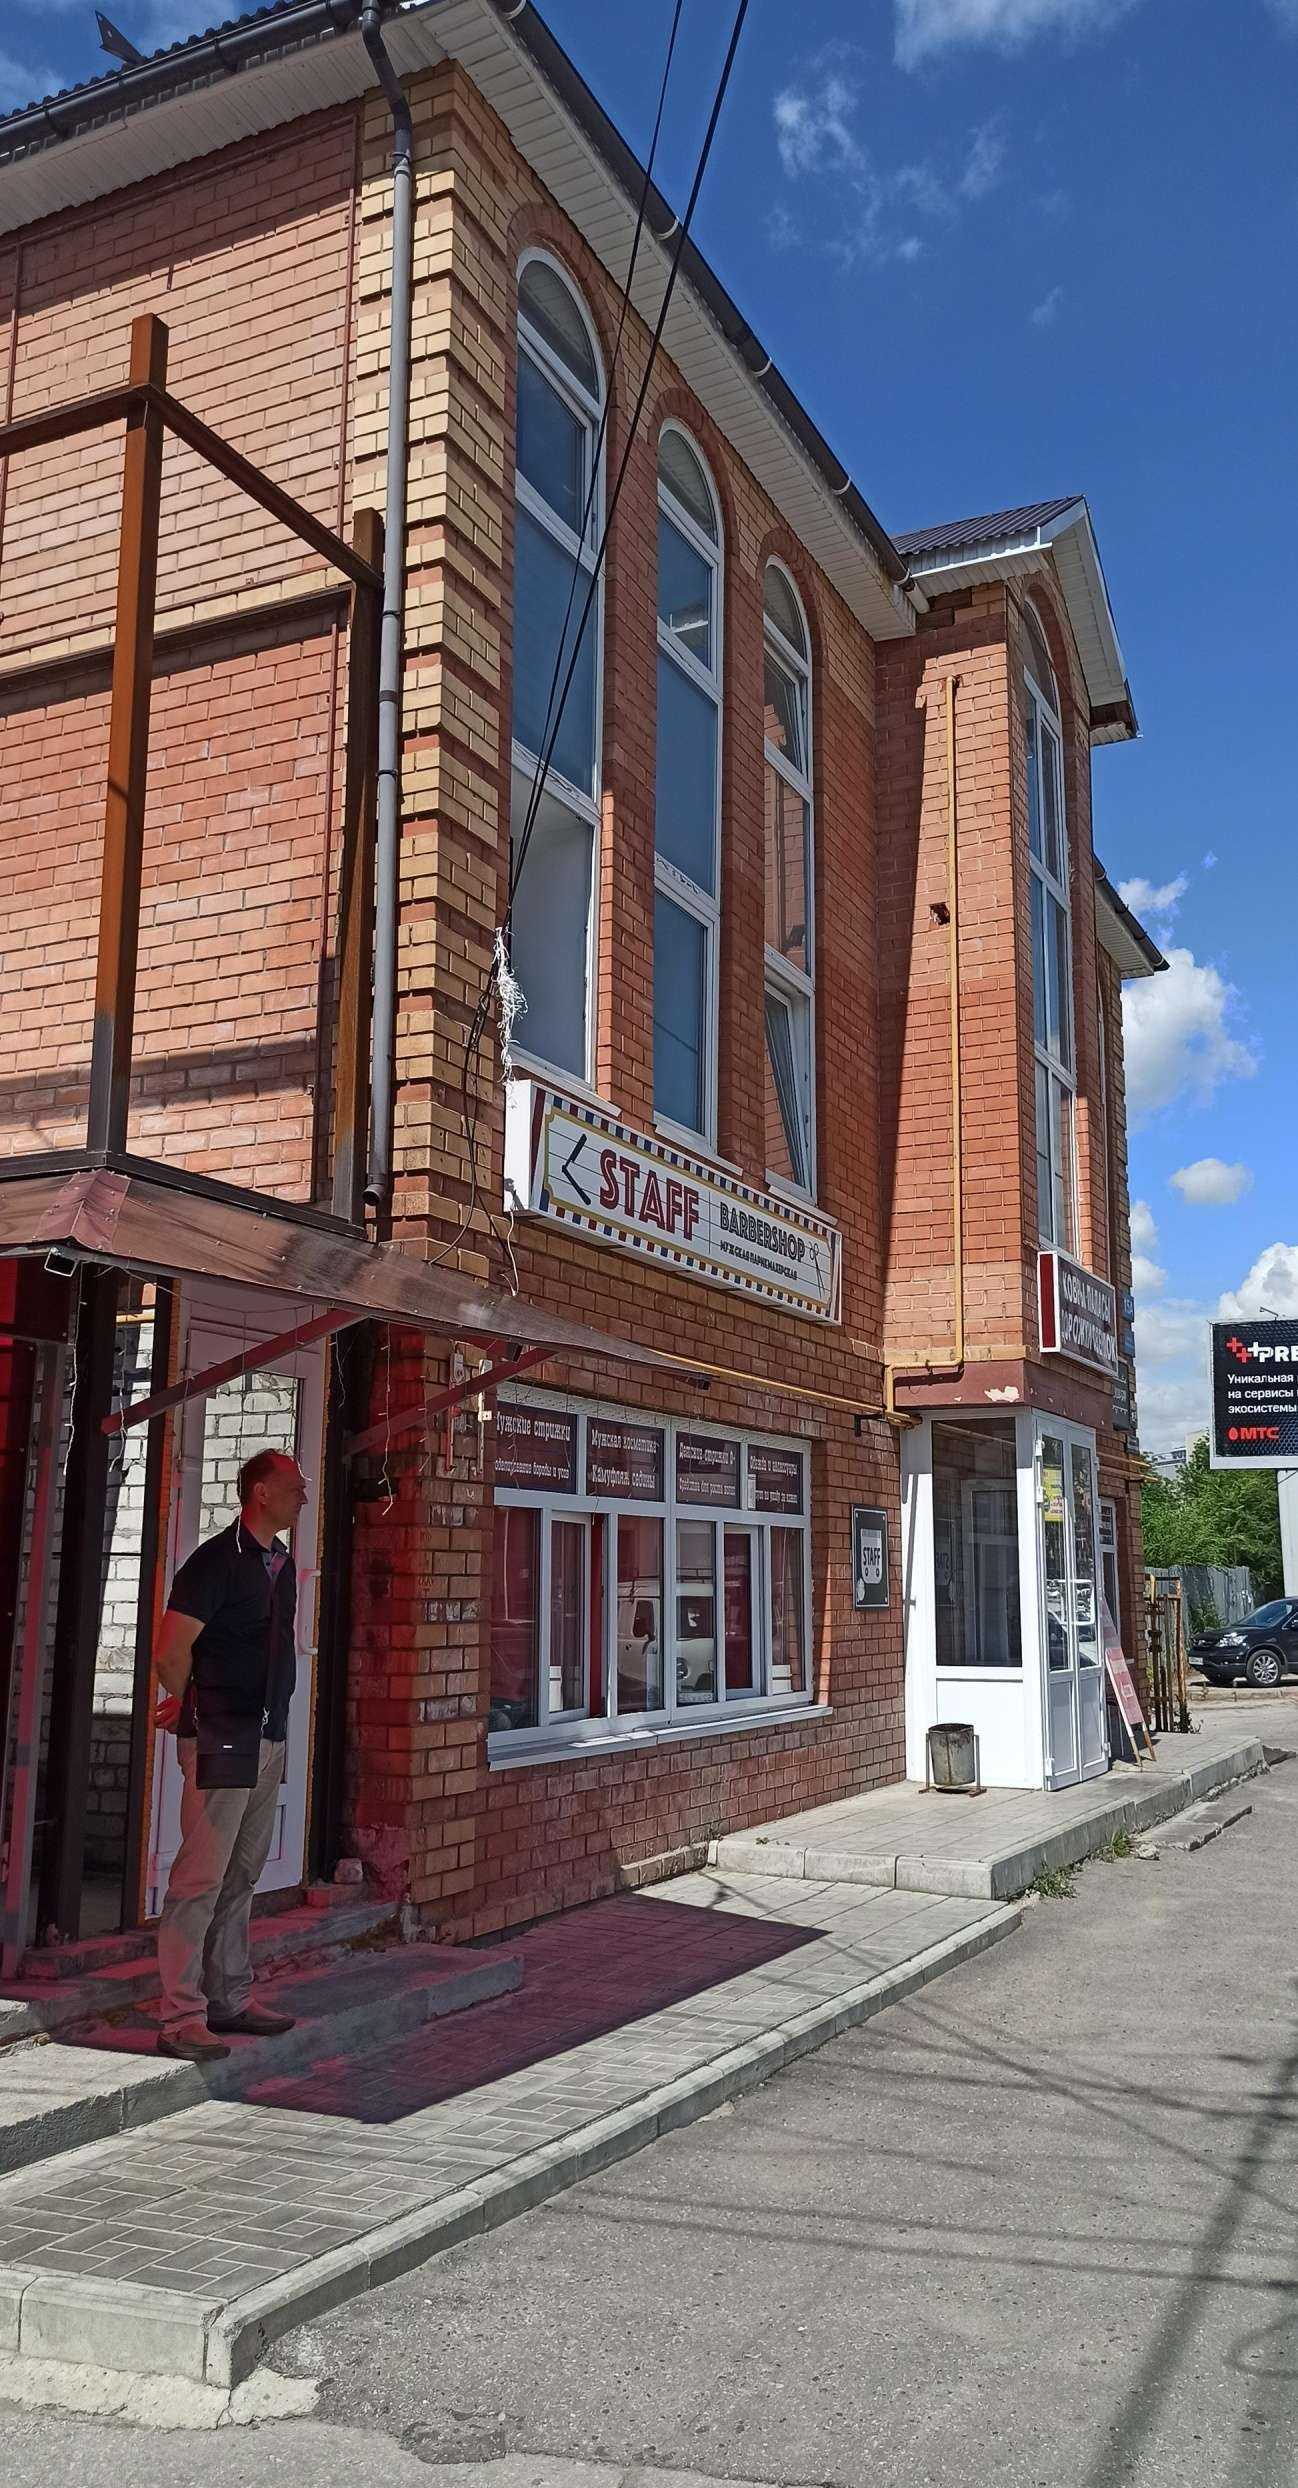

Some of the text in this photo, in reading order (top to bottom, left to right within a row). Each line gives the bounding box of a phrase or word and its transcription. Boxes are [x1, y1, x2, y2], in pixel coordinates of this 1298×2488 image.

[599, 1148, 700, 1241] STAFF
[719, 1202, 806, 1263] BARBERSHOP
[720, 1240, 749, 1261] МУЖСКАЯ
[1227, 1373, 1294, 1385] Уникальная
[1227, 1389, 1294, 1401] на сервисы
[1227, 1404, 1297, 1414] экосистемы
[534, 1420, 571, 1441] стрижки
[591, 1429, 621, 1448] Мужская
[1240, 1426, 1280, 1440] МТС
[862, 1546, 881, 1567] STAFF
